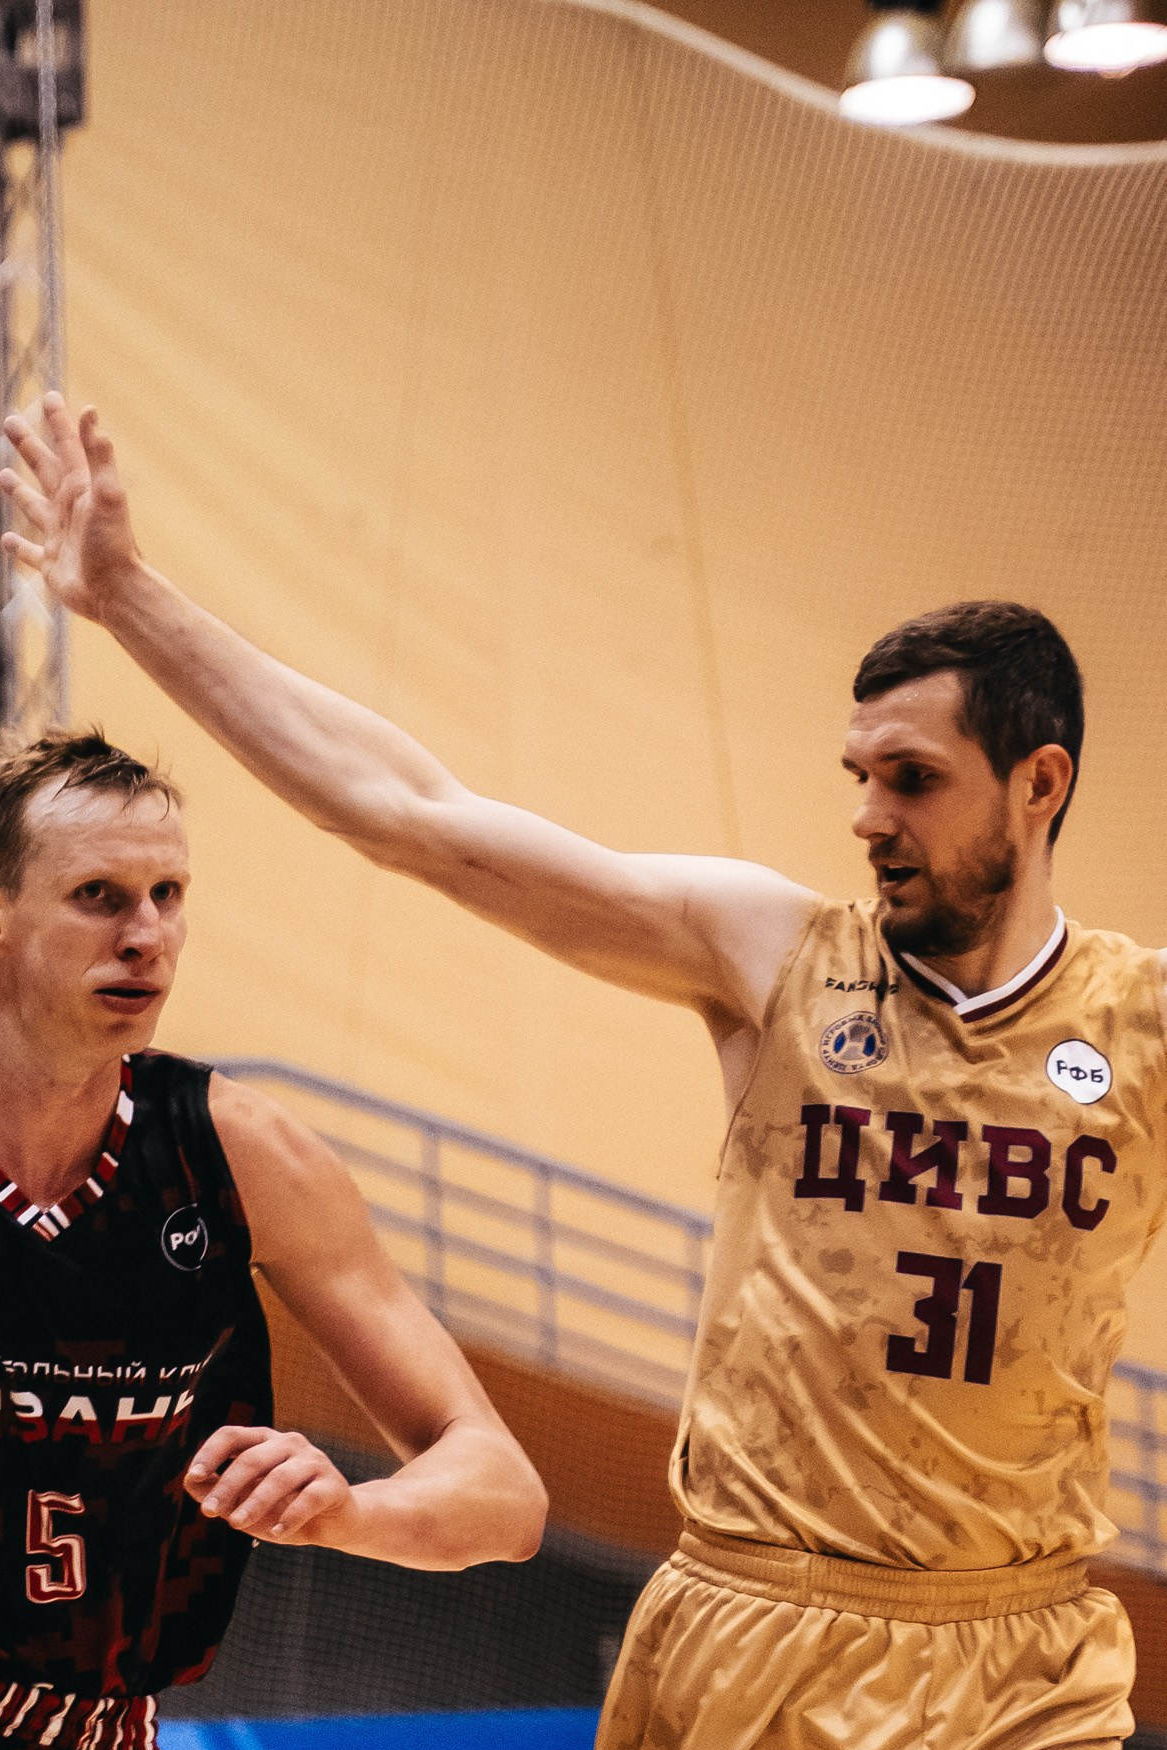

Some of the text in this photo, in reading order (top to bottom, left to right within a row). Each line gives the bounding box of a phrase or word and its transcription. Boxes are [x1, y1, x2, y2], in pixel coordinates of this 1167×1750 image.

[793, 1103, 1118, 1232] ЦИВС
[885, 1250, 1003, 1386] 31
[25, 1489, 88, 1604] 5
